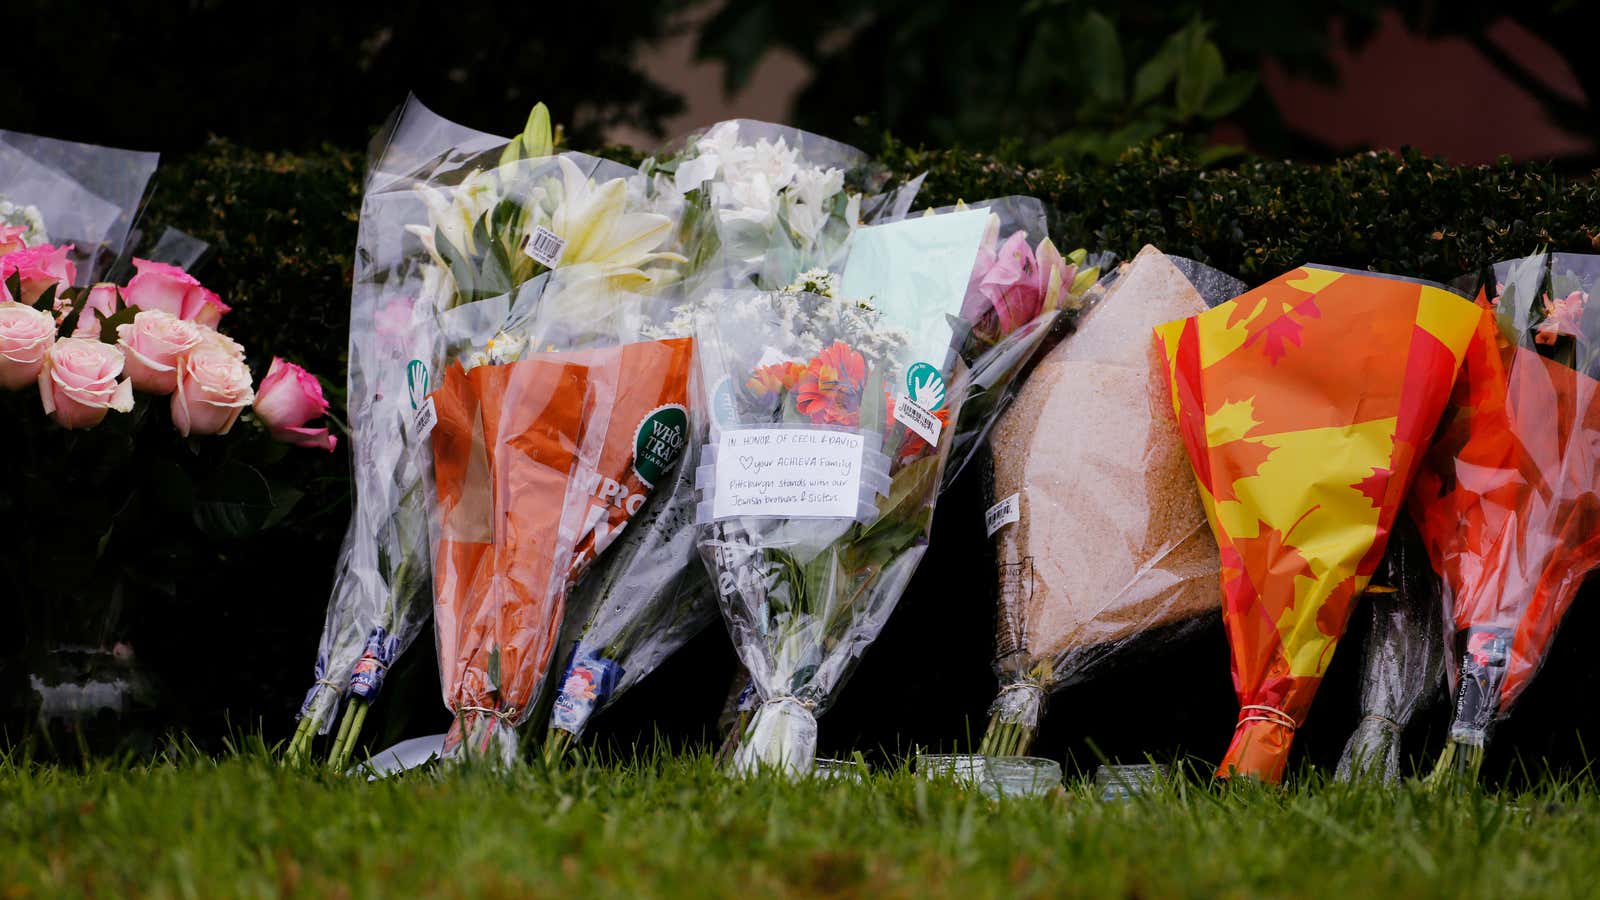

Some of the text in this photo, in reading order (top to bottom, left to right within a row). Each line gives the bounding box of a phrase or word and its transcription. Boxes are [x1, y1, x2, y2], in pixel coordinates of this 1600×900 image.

[728, 437, 737, 447] IN
[743, 435, 770, 446] HONOR
[776, 434, 788, 445] OF
[792, 434, 817, 444] CECIL
[829, 435, 858, 449] DAVID
[754, 456, 852, 476] your ACHIEVA Family
[729, 479, 849, 495] Pittsburgh stands with our
[730, 494, 762, 507] Jewish
[764, 494, 798, 504] brothers
[800, 490, 808, 502] &
